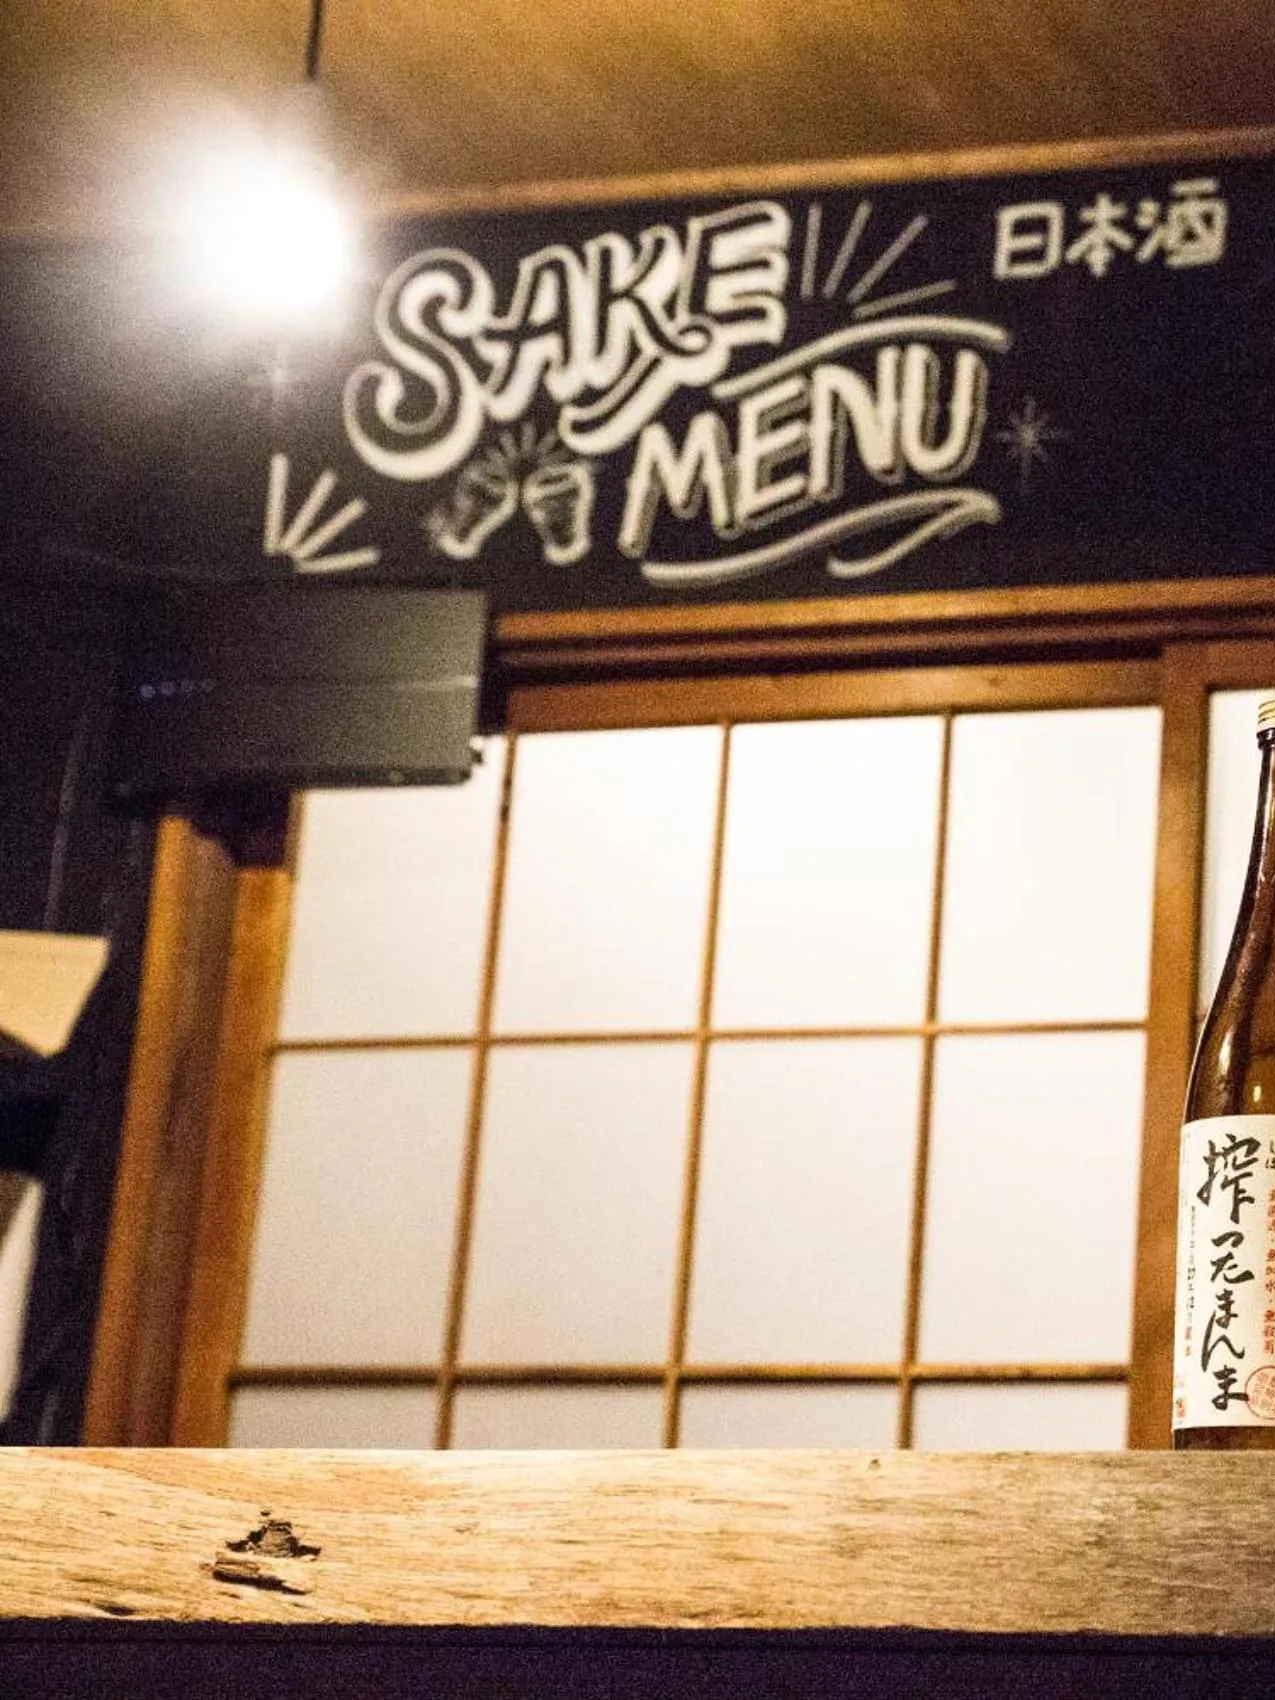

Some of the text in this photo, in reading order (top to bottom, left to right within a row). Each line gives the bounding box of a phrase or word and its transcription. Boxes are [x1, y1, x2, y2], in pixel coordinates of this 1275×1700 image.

[343, 199, 794, 481] SAKE
[994, 178, 1227, 280] 日本酒
[618, 342, 990, 558] MENU
[1195, 1133, 1261, 1411] 搾ったまんま
